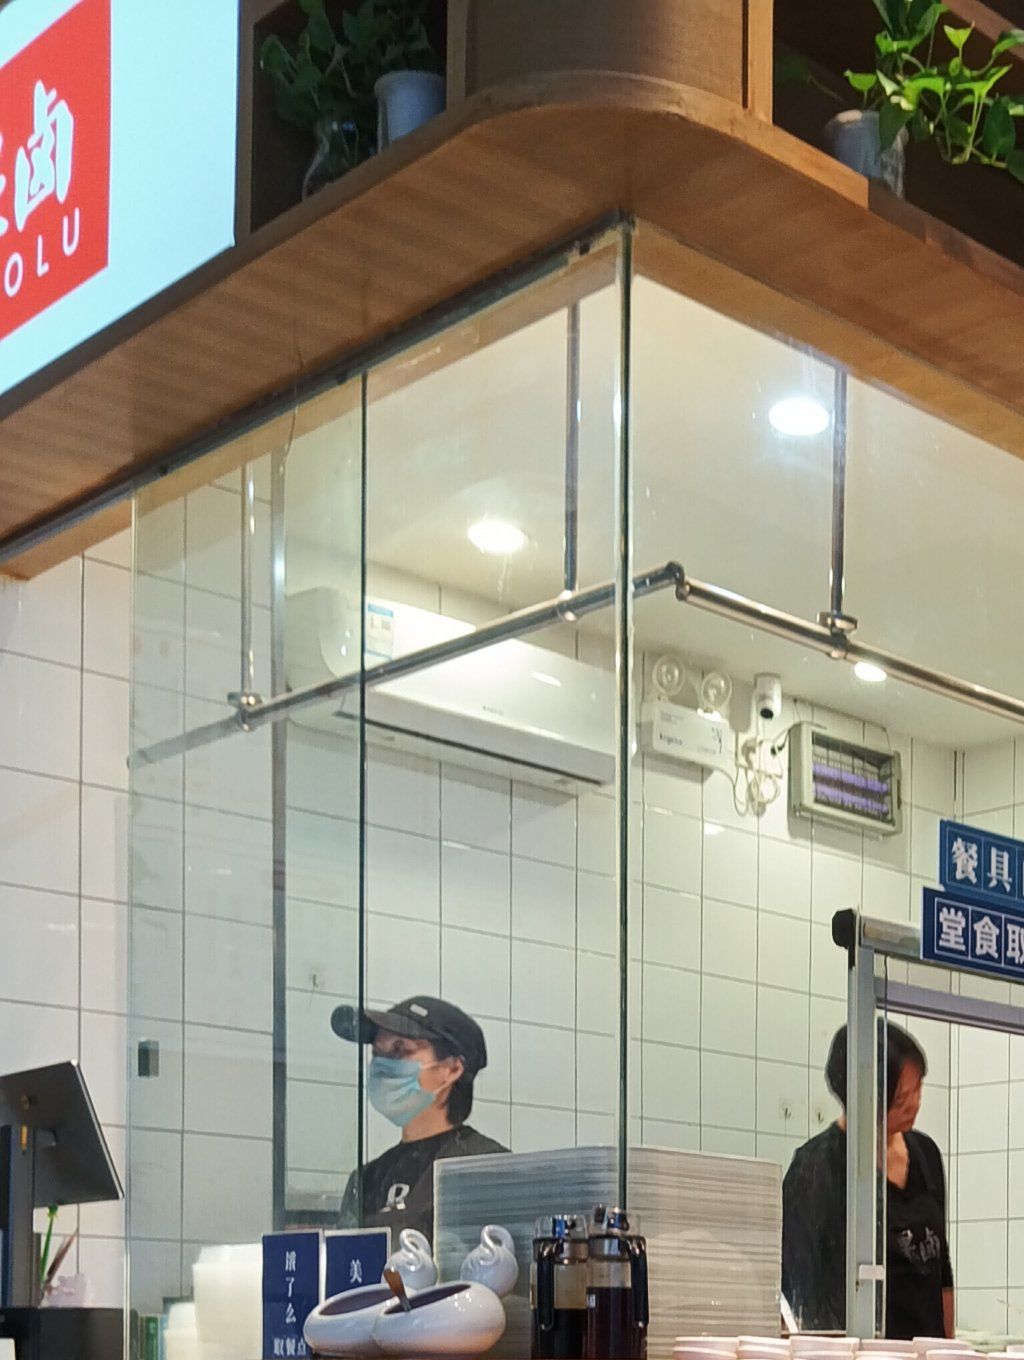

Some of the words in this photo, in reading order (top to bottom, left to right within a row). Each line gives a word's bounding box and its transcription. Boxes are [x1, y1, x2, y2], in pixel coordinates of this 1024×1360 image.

[349, 1258, 363, 1285] 美
[273, 1337, 307, 1357] 取餐点
